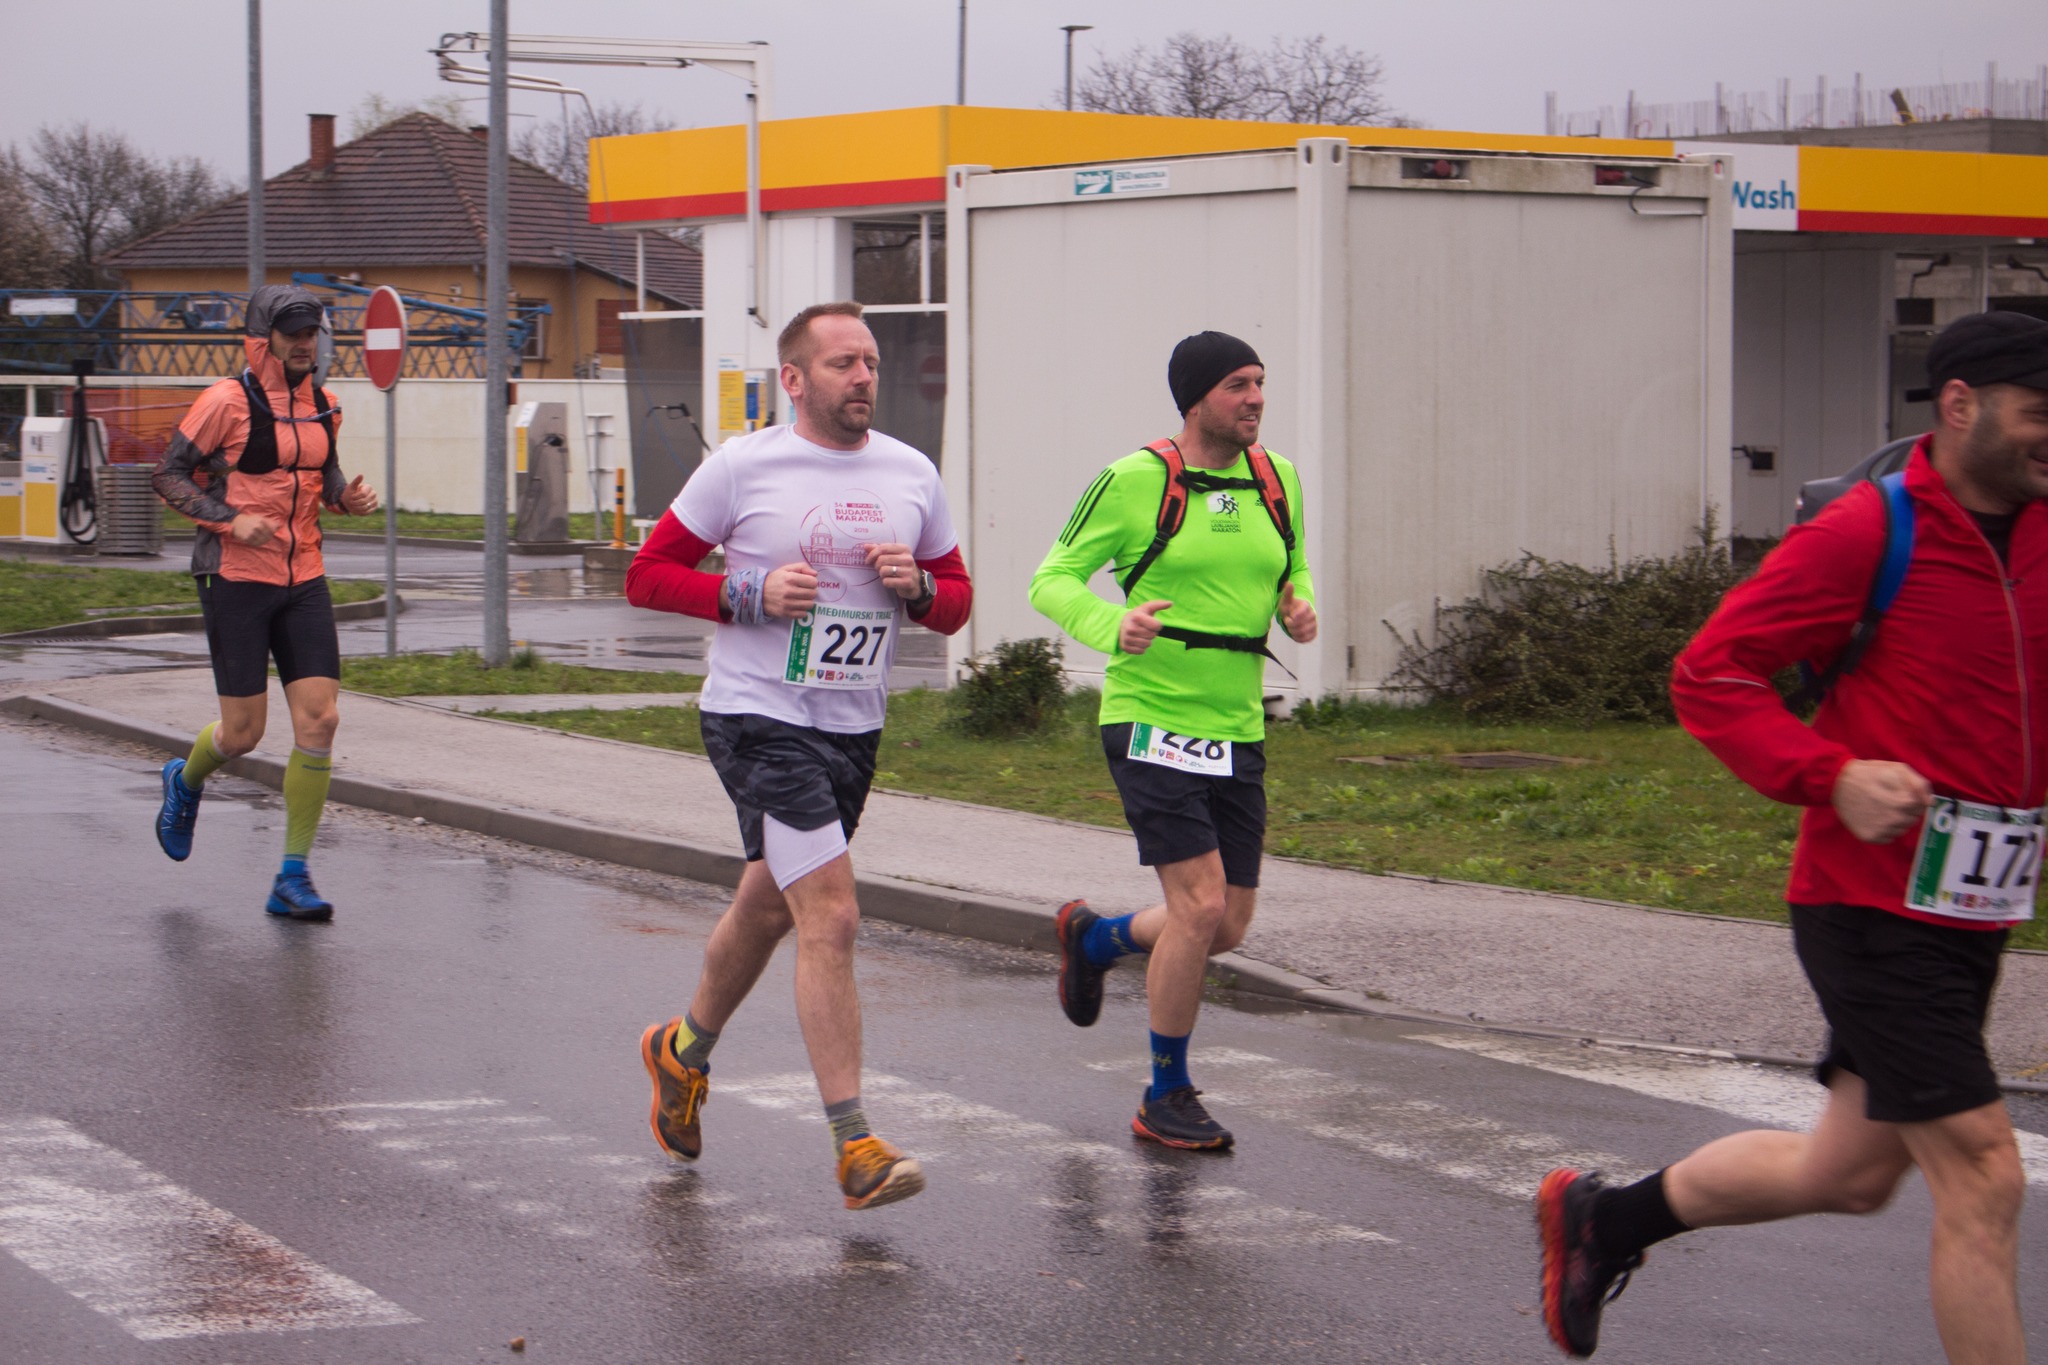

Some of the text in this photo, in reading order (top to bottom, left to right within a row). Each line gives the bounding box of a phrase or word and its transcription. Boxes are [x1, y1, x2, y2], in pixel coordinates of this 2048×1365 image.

[835, 509, 883, 517] BUDAPEST
[836, 515, 883, 523] MARATON
[817, 606, 873, 620] MEĐIMURSKI
[820, 623, 887, 666] 227
